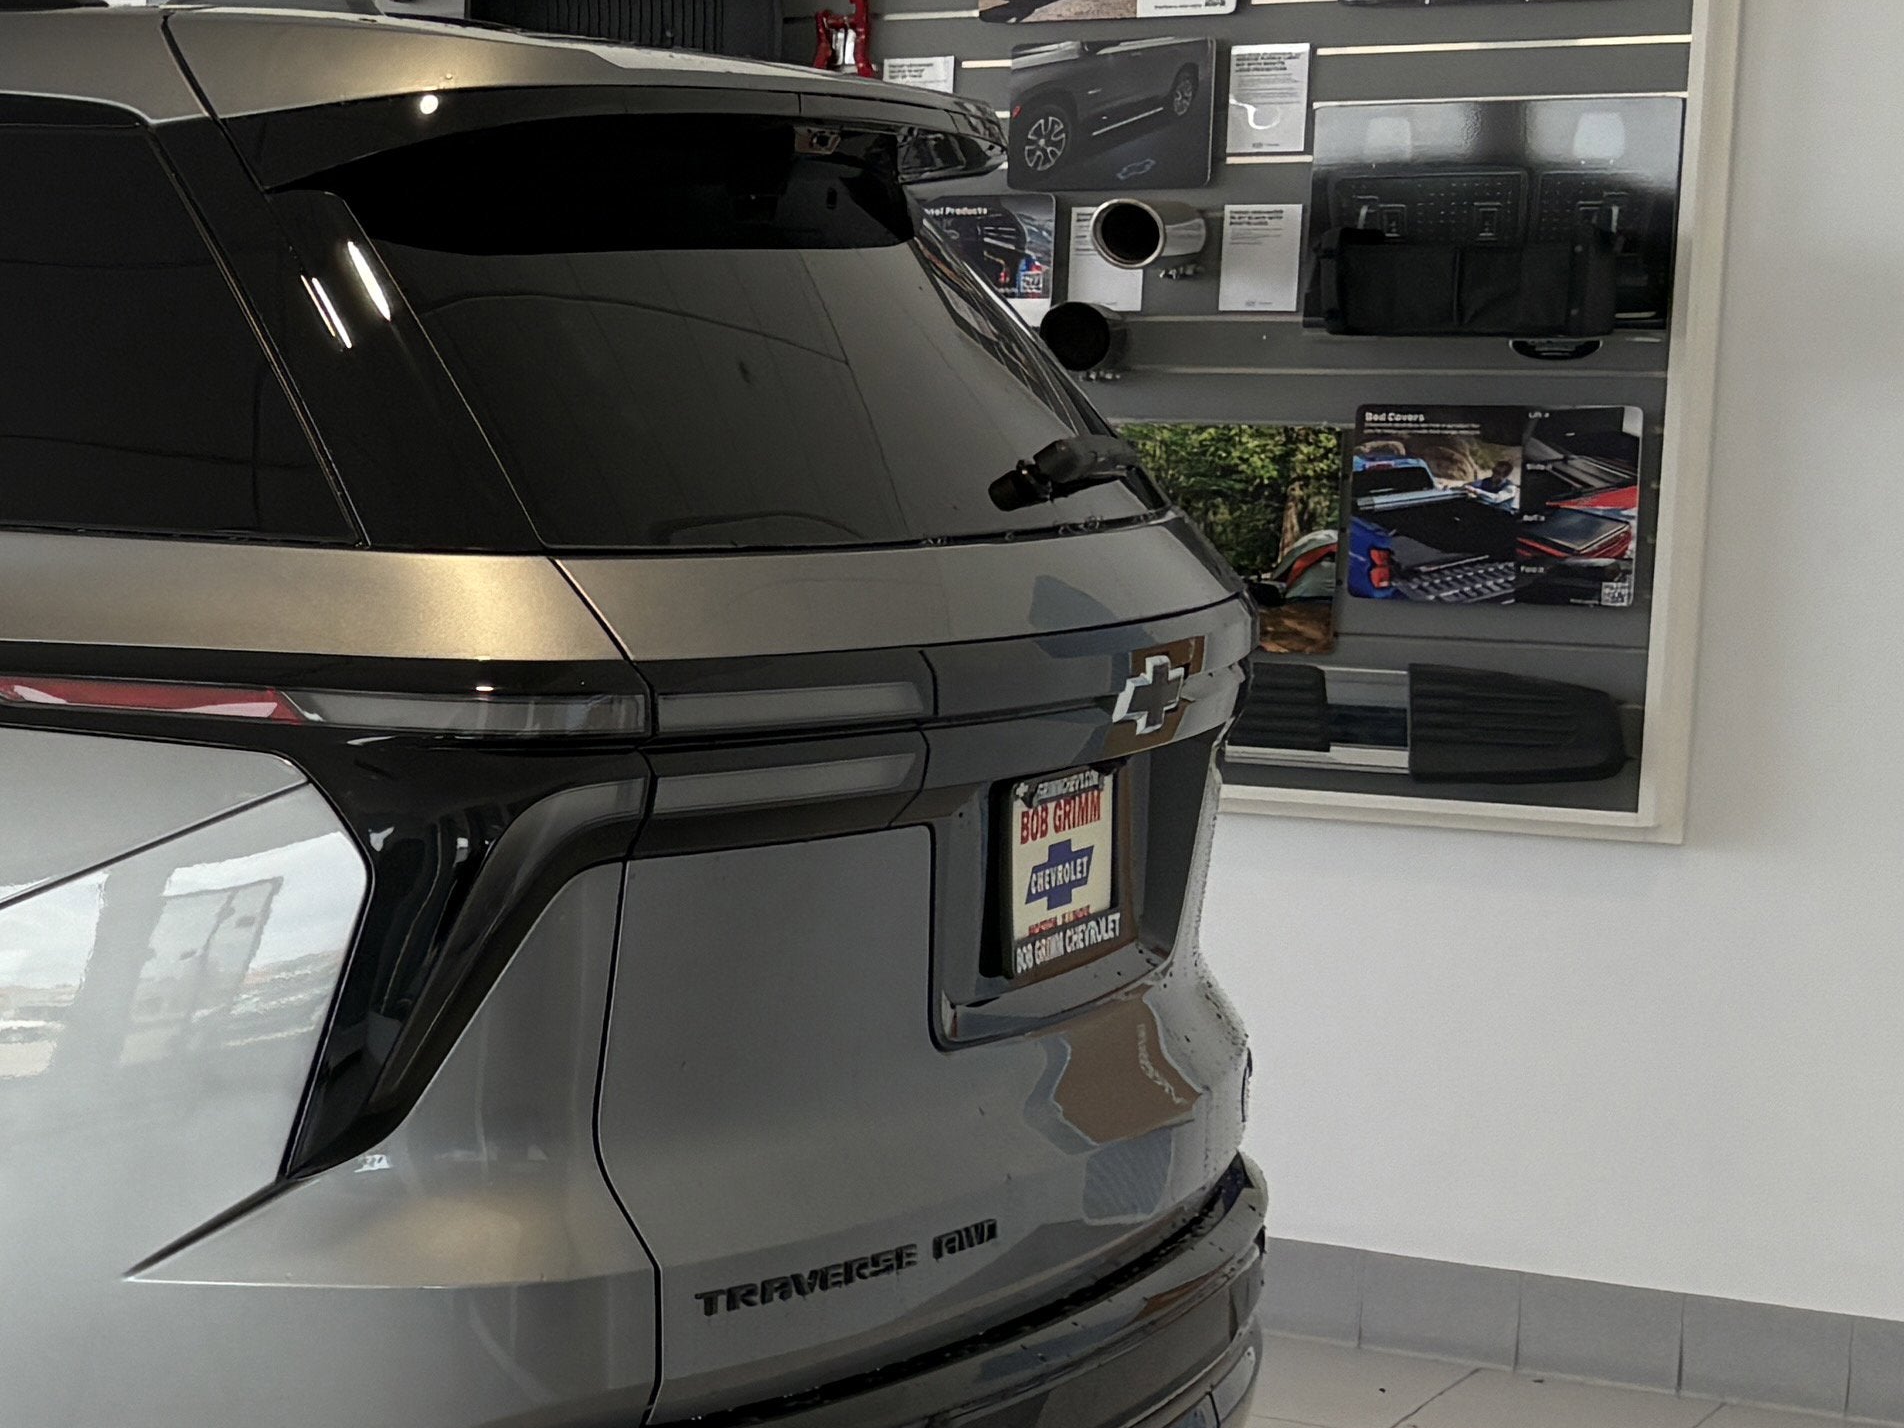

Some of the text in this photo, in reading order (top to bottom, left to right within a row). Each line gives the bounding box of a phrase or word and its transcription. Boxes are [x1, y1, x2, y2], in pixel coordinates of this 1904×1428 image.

[1365, 411, 1425, 422] Bed Covers
[1020, 789, 1101, 845] BOB GRIMM
[1030, 856, 1089, 895] CHEVROLET
[1065, 912, 1121, 954] CHEVROLET
[694, 1243, 918, 1317] TRAVERSE
